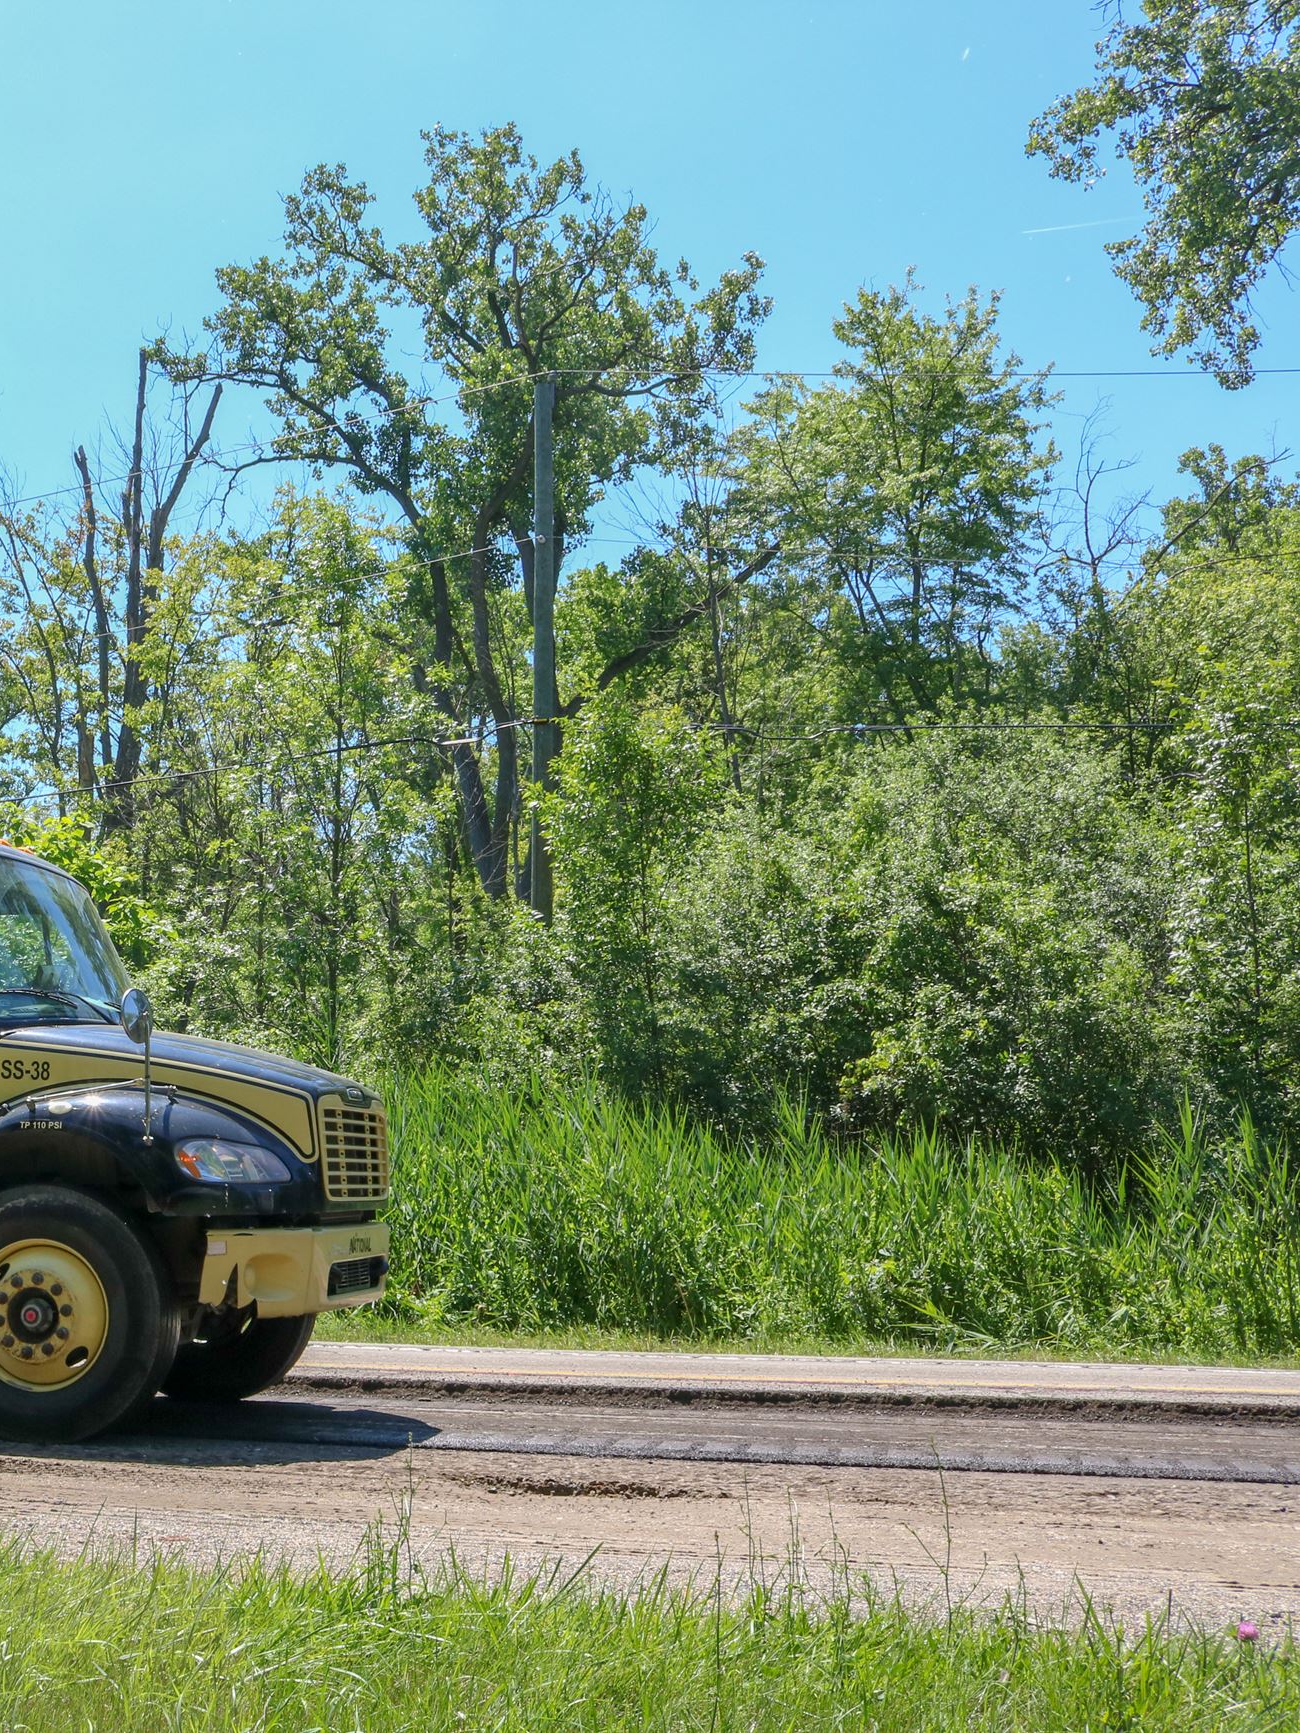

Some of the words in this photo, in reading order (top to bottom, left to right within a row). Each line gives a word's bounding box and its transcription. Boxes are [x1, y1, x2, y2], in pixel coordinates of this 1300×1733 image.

[1, 1060, 50, 1080] SS-38
[20, 1121, 30, 1129] TP
[32, 1121, 47, 1129] 110
[48, 1121, 63, 1129] PSI
